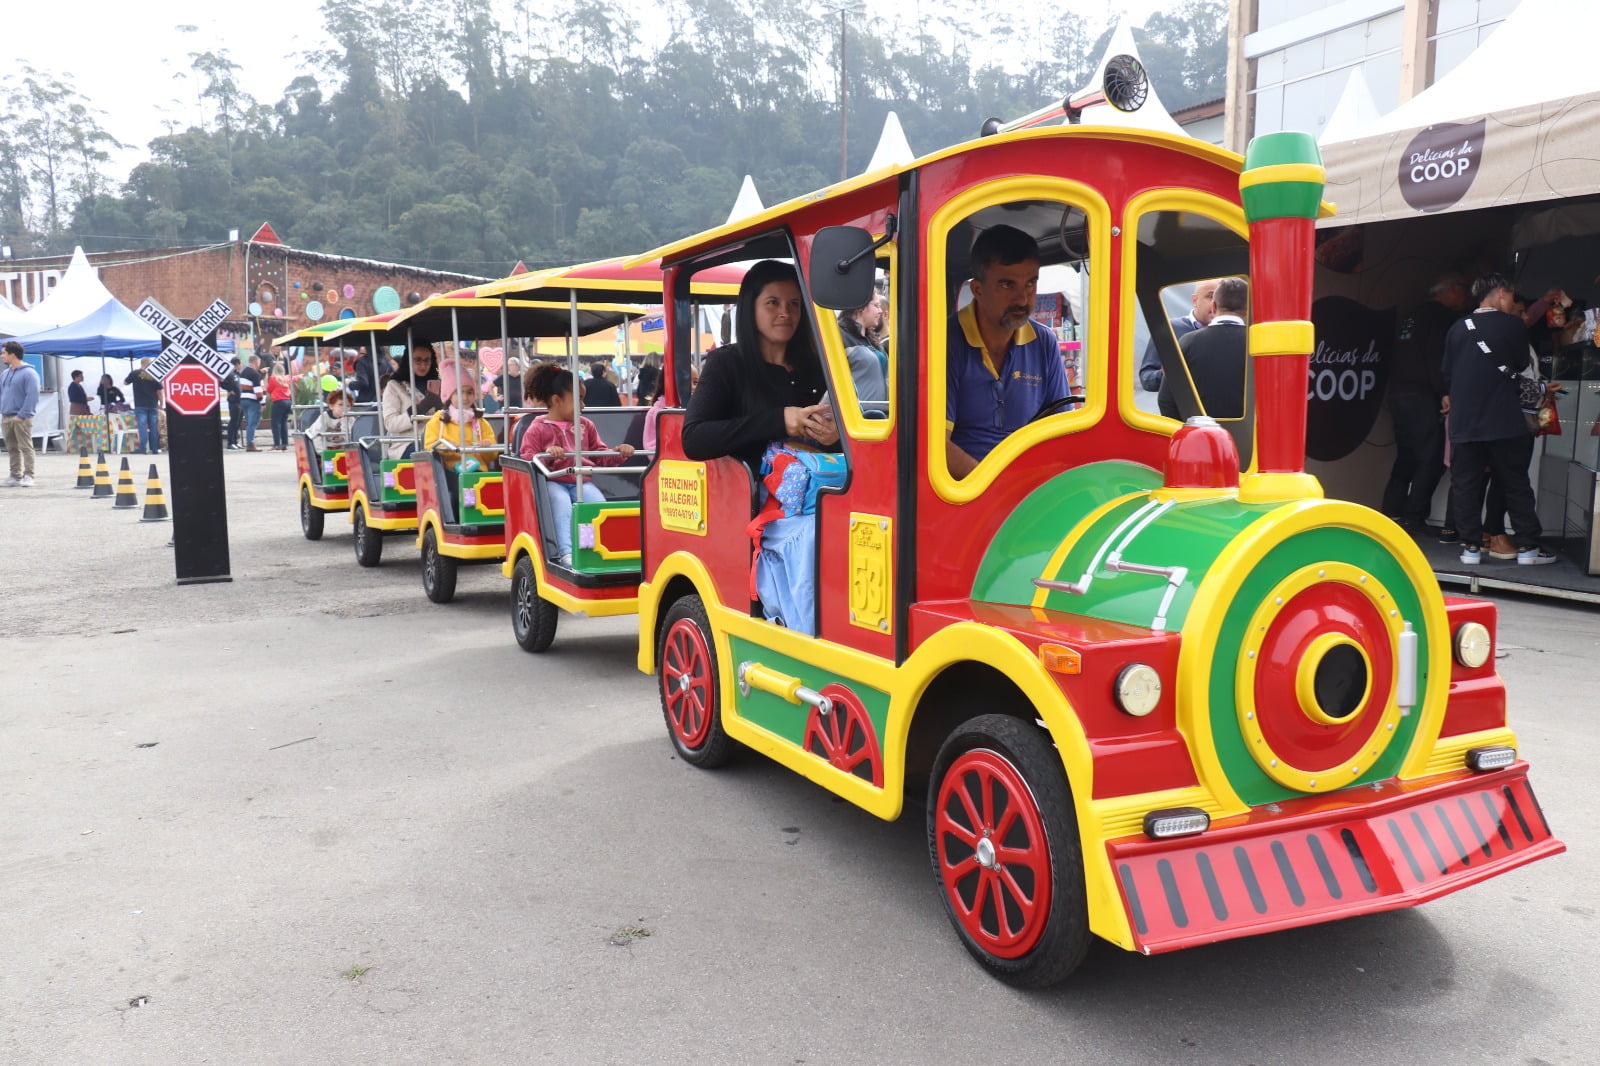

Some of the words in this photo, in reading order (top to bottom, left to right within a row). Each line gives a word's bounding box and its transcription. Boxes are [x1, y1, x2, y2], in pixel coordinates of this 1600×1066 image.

[1410, 148, 1455, 165] Delícias
[1457, 140, 1473, 155] da
[1410, 157, 1470, 183] COOP
[189, 301, 231, 339] FERREA
[139, 304, 231, 377] CRUZAMENTO
[1309, 339, 1359, 366] elícias
[1361, 339, 1382, 363] da
[147, 348, 183, 380] LINHA
[171, 382, 215, 396] PARE
[660, 477, 699, 492] TRENZINHO
[670, 492, 699, 507] ALEGRIA
